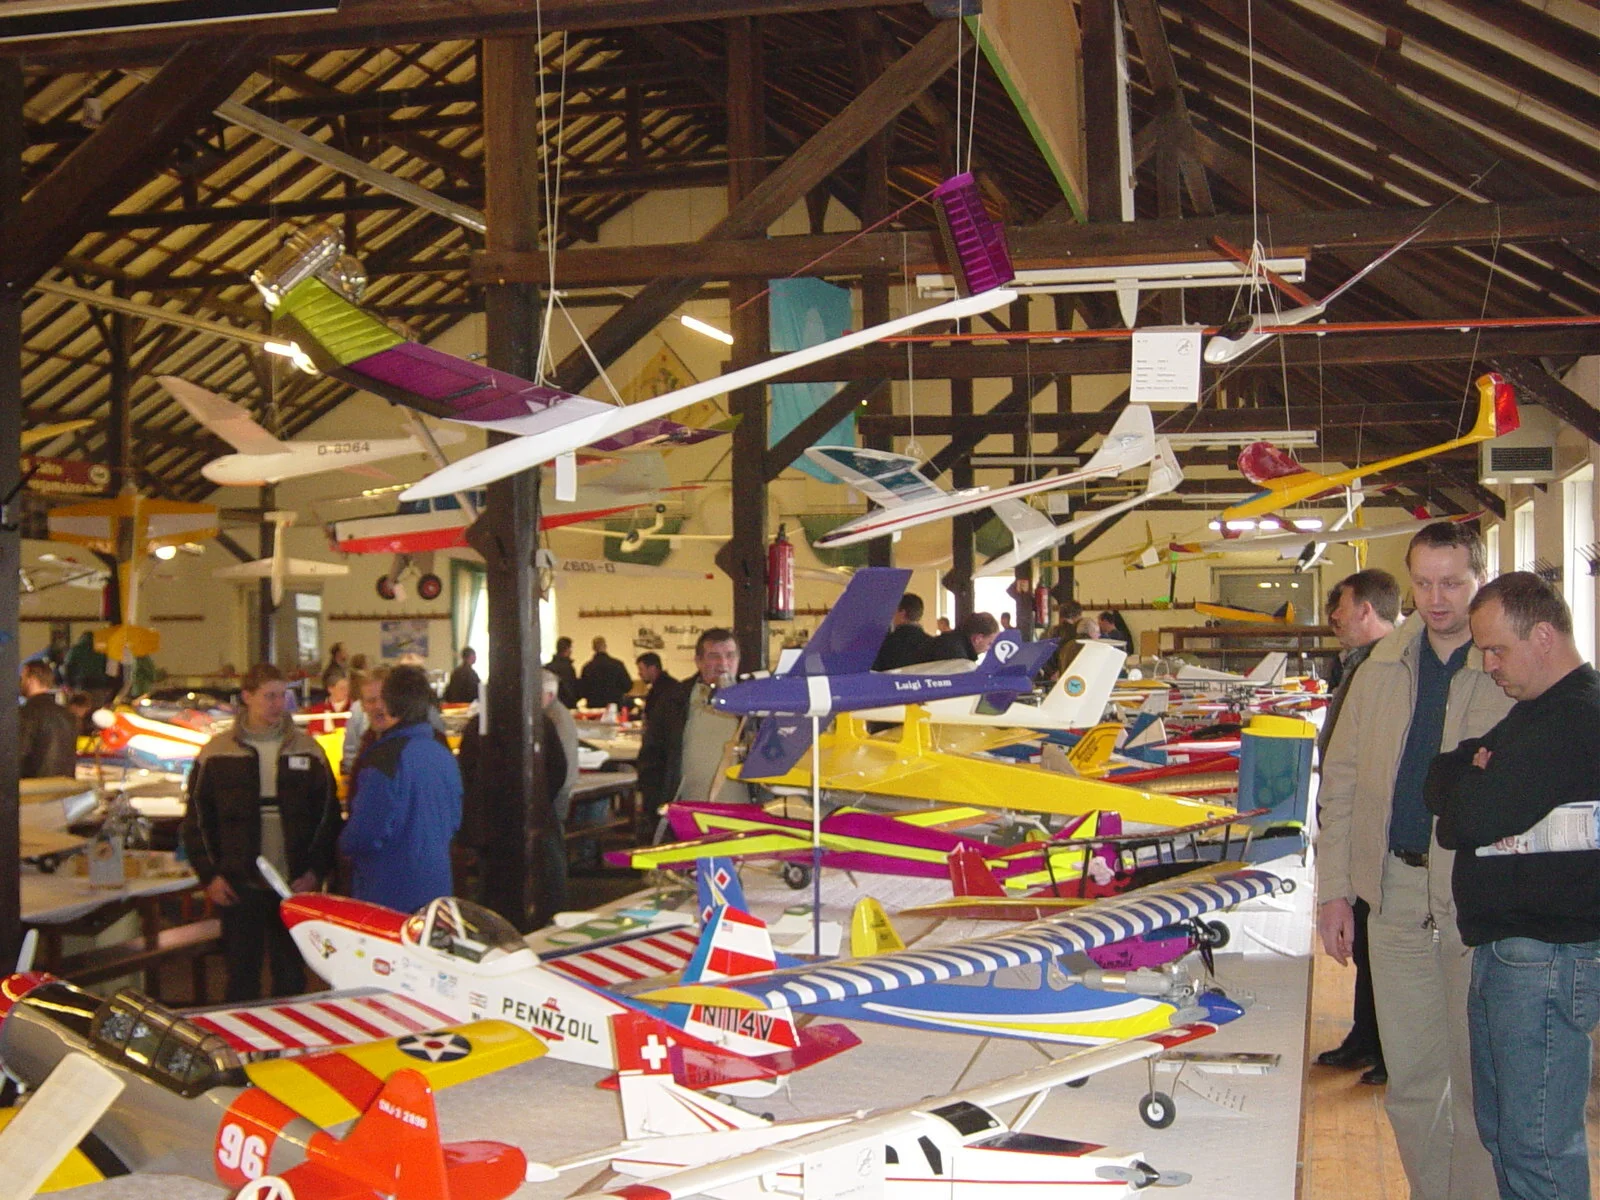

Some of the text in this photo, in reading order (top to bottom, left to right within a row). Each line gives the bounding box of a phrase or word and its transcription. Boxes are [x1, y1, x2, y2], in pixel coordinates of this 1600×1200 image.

[894, 679, 953, 691] Luigi Team
[502, 997, 599, 1045] PENNZOIL
[218, 1123, 268, 1181] 96
